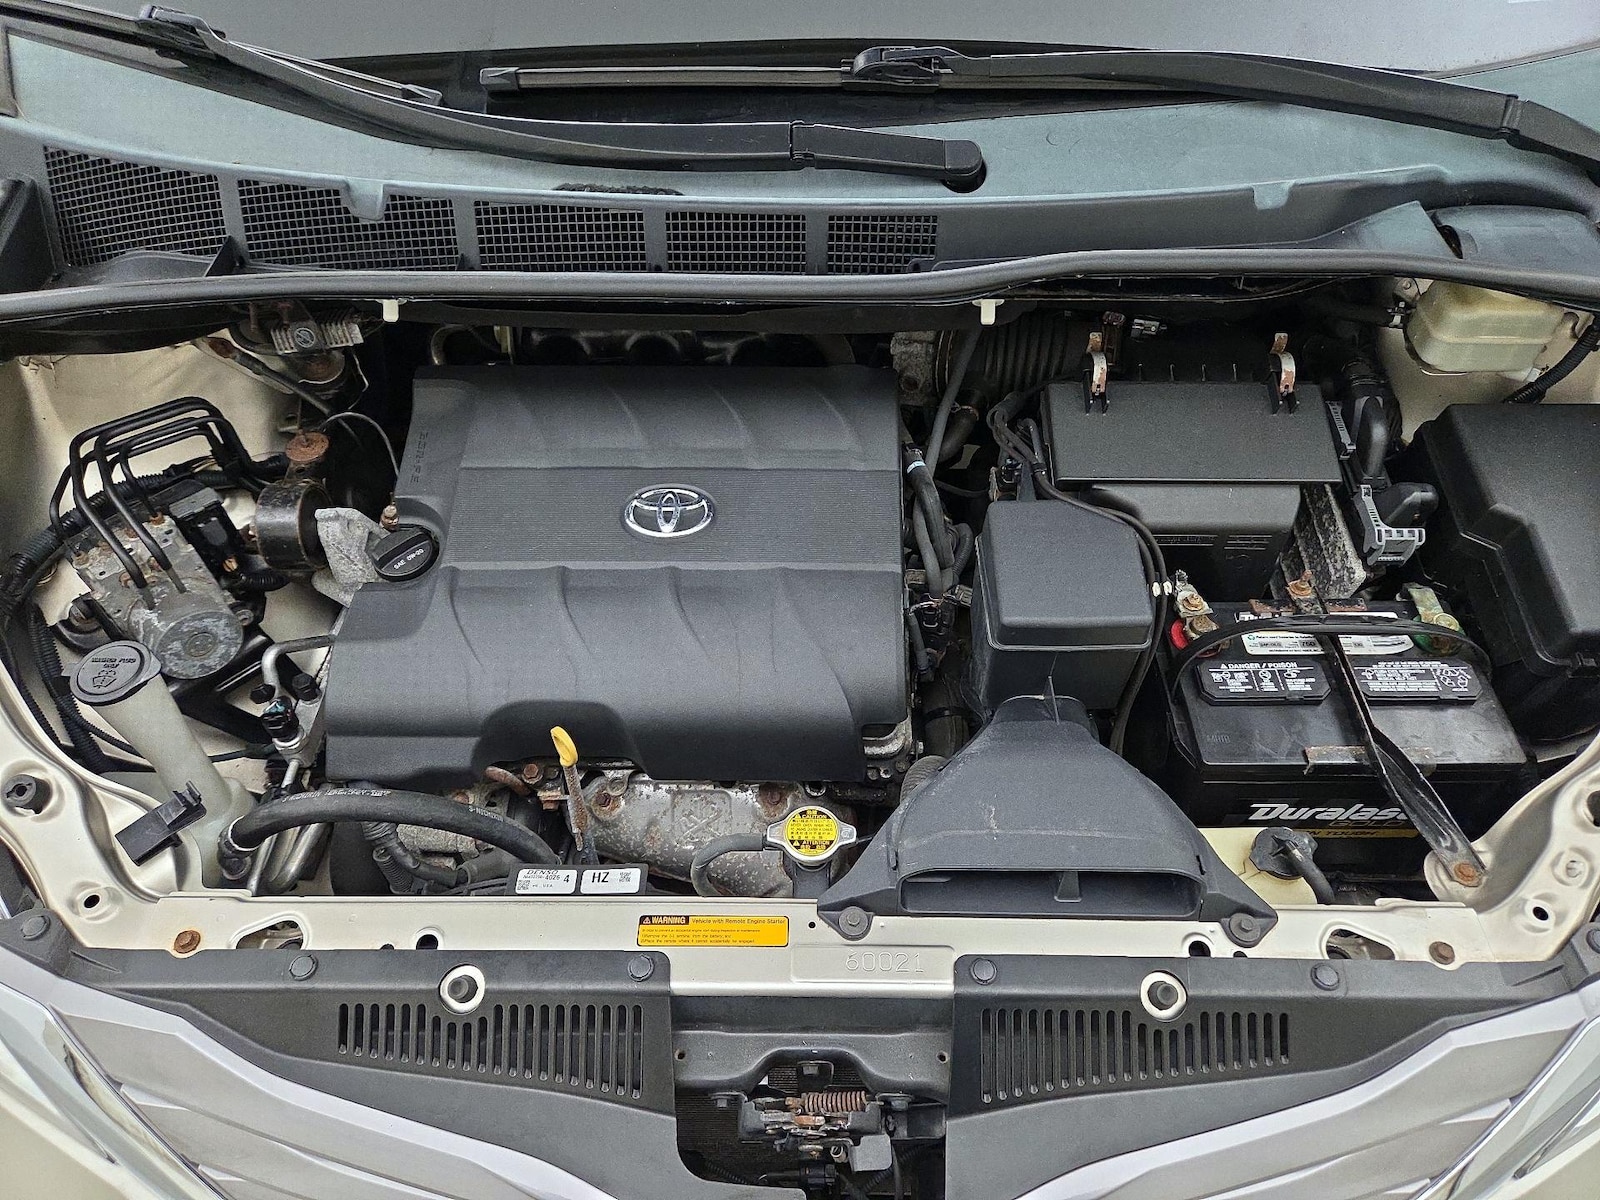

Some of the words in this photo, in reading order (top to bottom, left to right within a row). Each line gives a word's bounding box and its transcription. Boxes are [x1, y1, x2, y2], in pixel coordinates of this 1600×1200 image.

[394, 560, 406, 569] SAE
[563, 874, 570, 883] 4
[592, 871, 610, 883] HZ
[651, 916, 686, 924] WARNING
[845, 949, 924, 972] 60021
